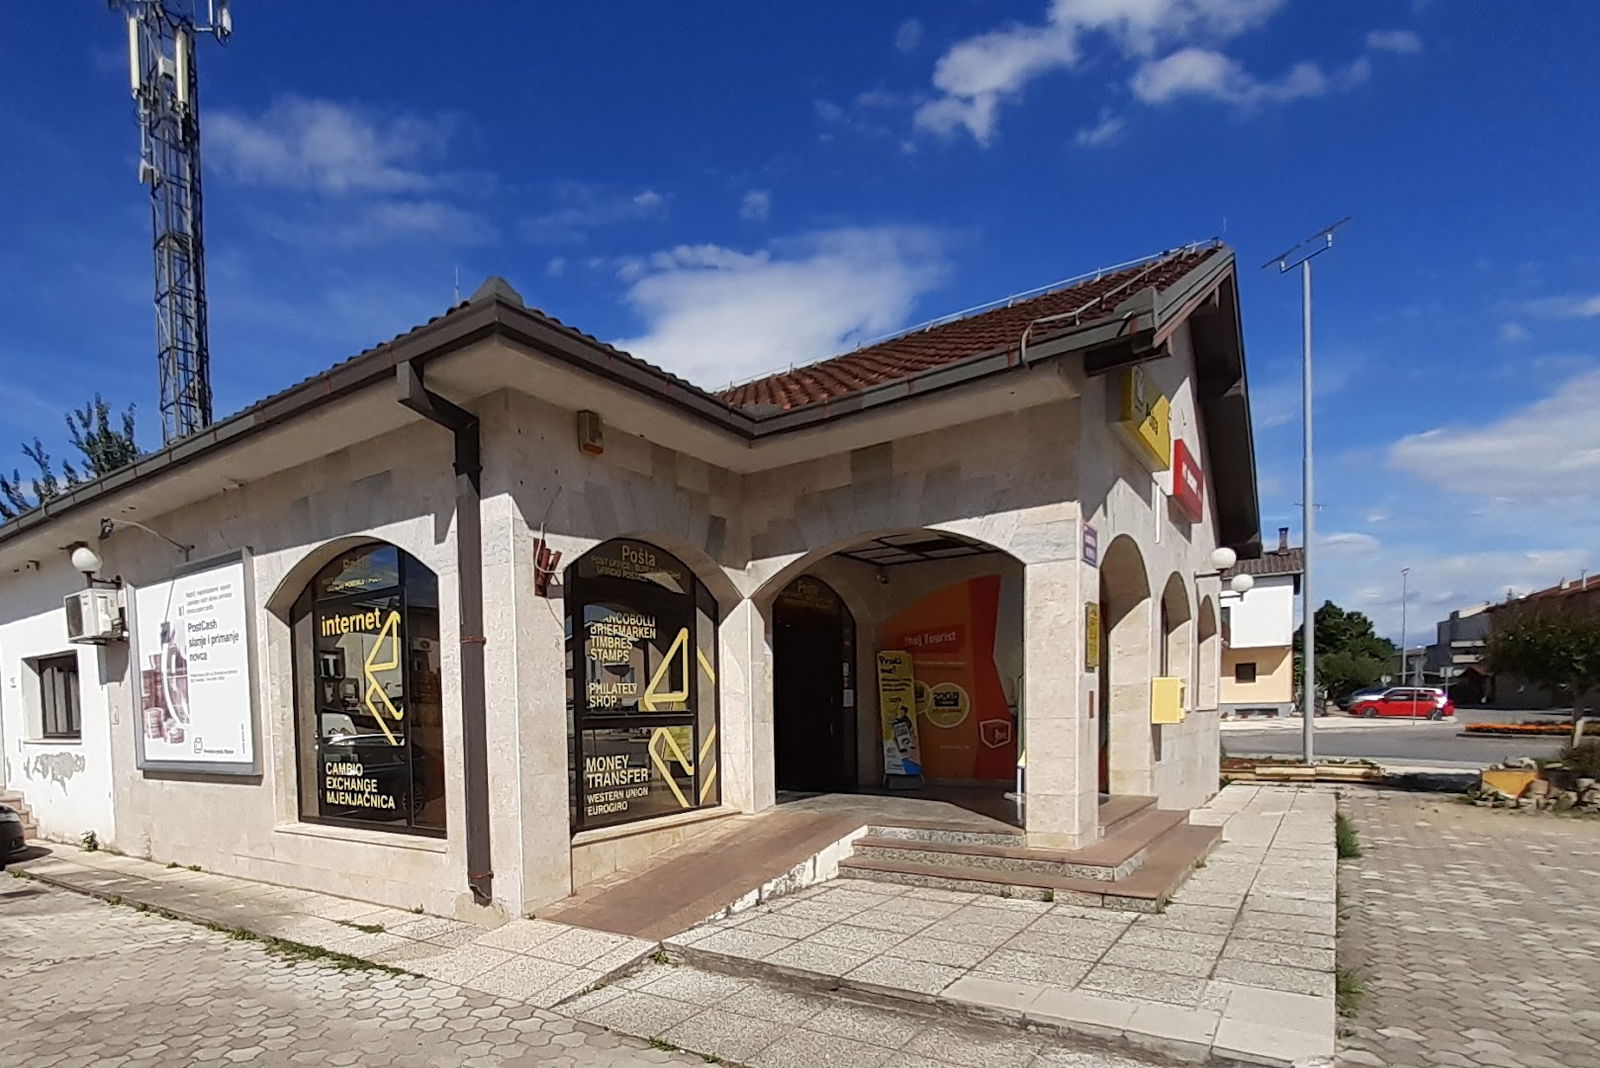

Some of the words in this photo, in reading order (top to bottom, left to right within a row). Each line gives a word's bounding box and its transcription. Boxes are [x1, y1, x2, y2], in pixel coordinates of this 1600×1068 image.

[188, 619, 217, 633] PostCash
[321, 607, 381, 637] internet
[602, 612, 656, 627] ANCOBOLLI
[590, 623, 656, 639] BRIEFMARKEN
[590, 635, 633, 650] TIMBRES
[590, 649, 630, 662] STAMPS
[589, 682, 638, 694] PHILATELY
[589, 695, 617, 708] SHOP
[325, 762, 364, 777] CAMBIO
[586, 754, 629, 773] MONEY
[326, 776, 378, 793] EXCHANGE
[586, 768, 649, 789] TRANSFER
[326, 790, 396, 810] MJENJAČNICA
[587, 789, 624, 804] WESTERN
[625, 786, 649, 799] UNION
[587, 801, 628, 816] EUROGIRO
